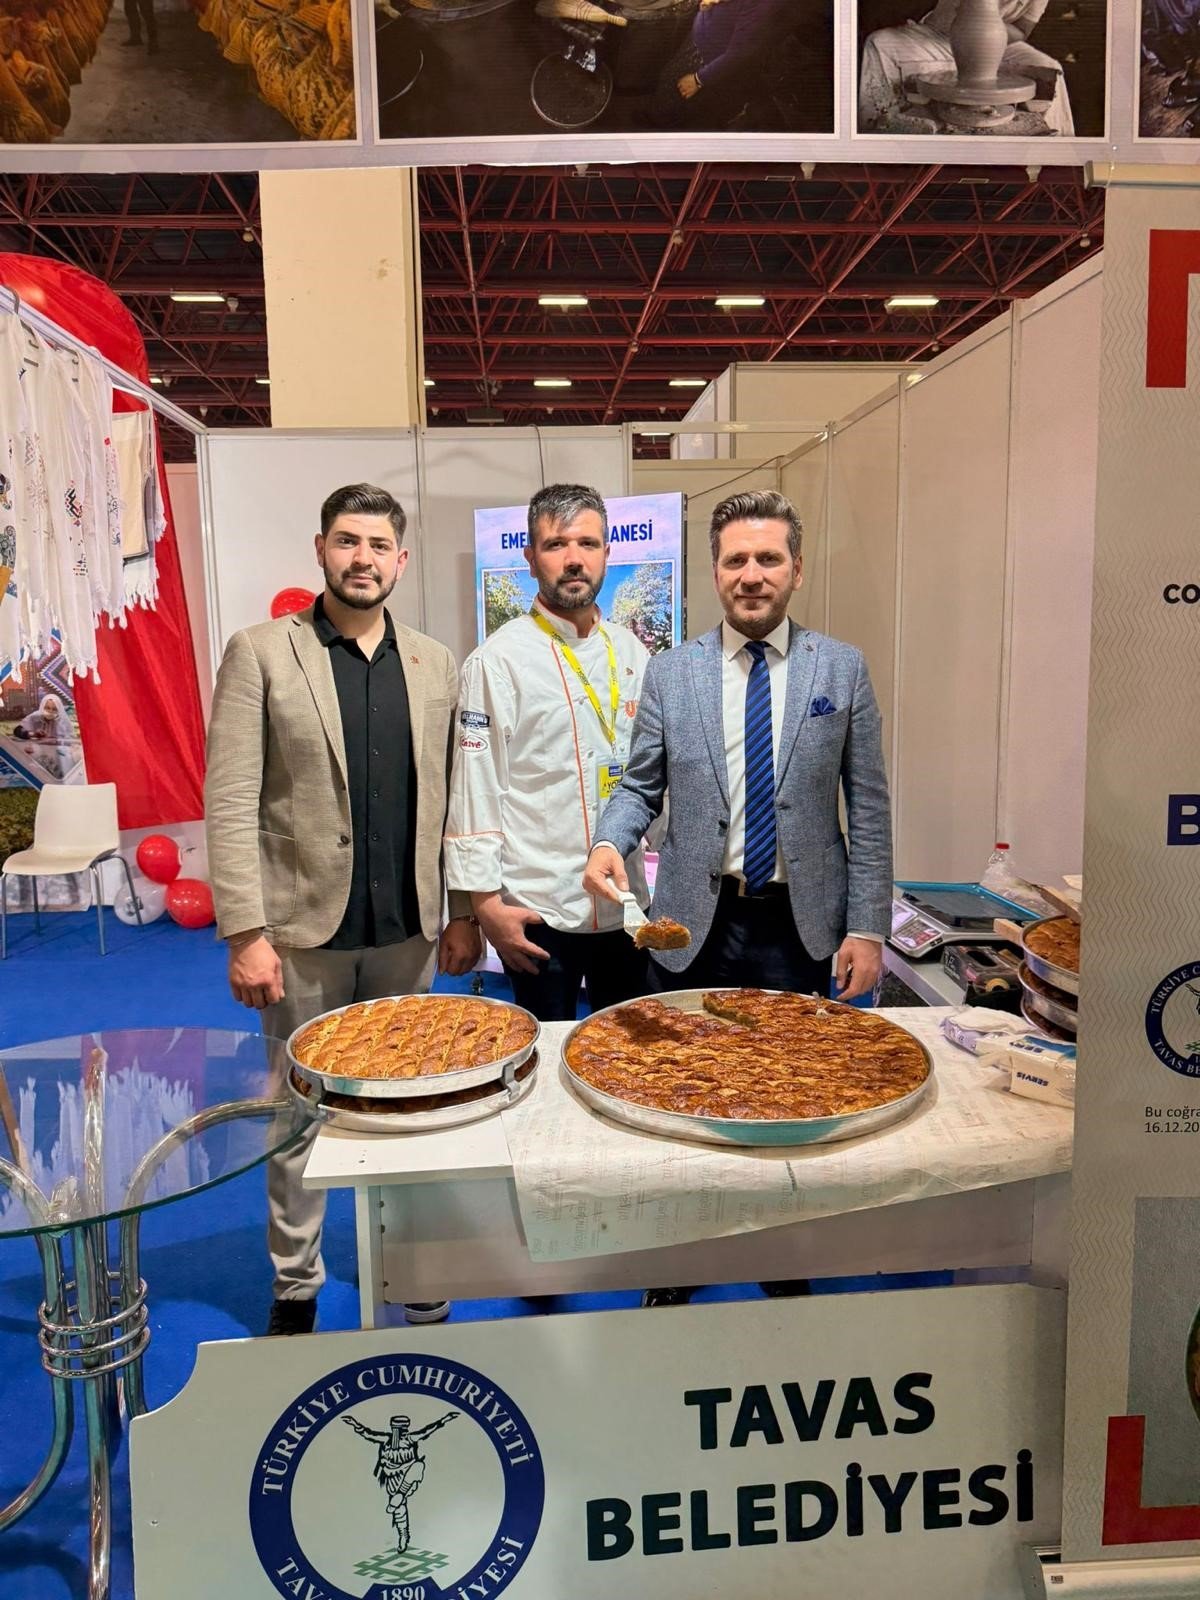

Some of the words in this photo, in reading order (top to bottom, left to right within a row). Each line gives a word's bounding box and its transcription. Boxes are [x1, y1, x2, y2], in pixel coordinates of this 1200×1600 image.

[501, 532, 530, 549] EME
[1163, 583, 1200, 604] CO
[1150, 969, 1190, 1015] TÜRKİYE
[1154, 1038, 1184, 1070] TAVAS
[1145, 1106, 1162, 1117] Bu
[1145, 1121, 1200, 1133] 16.12.20
[262, 1381, 350, 1496] TÜRKİYE
[356, 1364, 535, 1467] CUMHURİYETİ
[683, 1371, 936, 1451] TAVAS
[585, 1448, 1034, 1562] BELEDİYESİ
[277, 1556, 332, 1600] TAV
[449, 1536, 524, 1600] İYESİ
